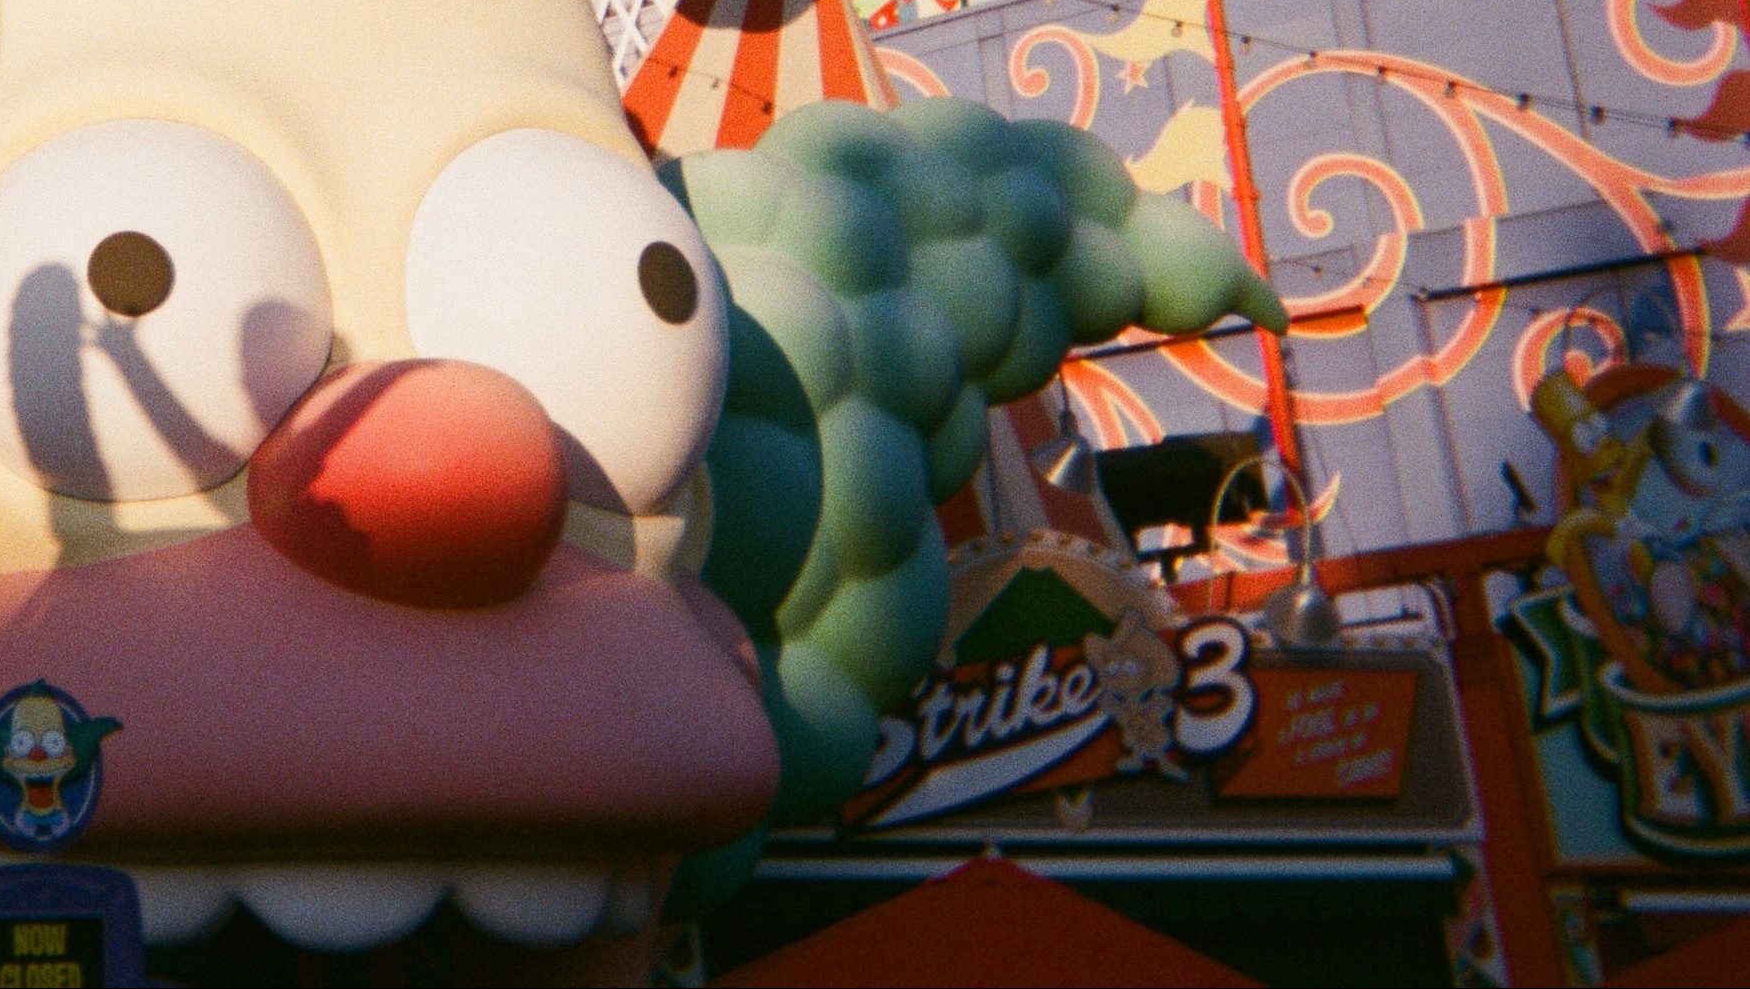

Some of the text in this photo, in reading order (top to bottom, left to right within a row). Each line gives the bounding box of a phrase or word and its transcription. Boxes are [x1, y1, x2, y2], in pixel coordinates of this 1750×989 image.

[1173, 619, 1256, 754] 3
[1624, 709, 1750, 826] EY
[12, 923, 69, 956] NOW
